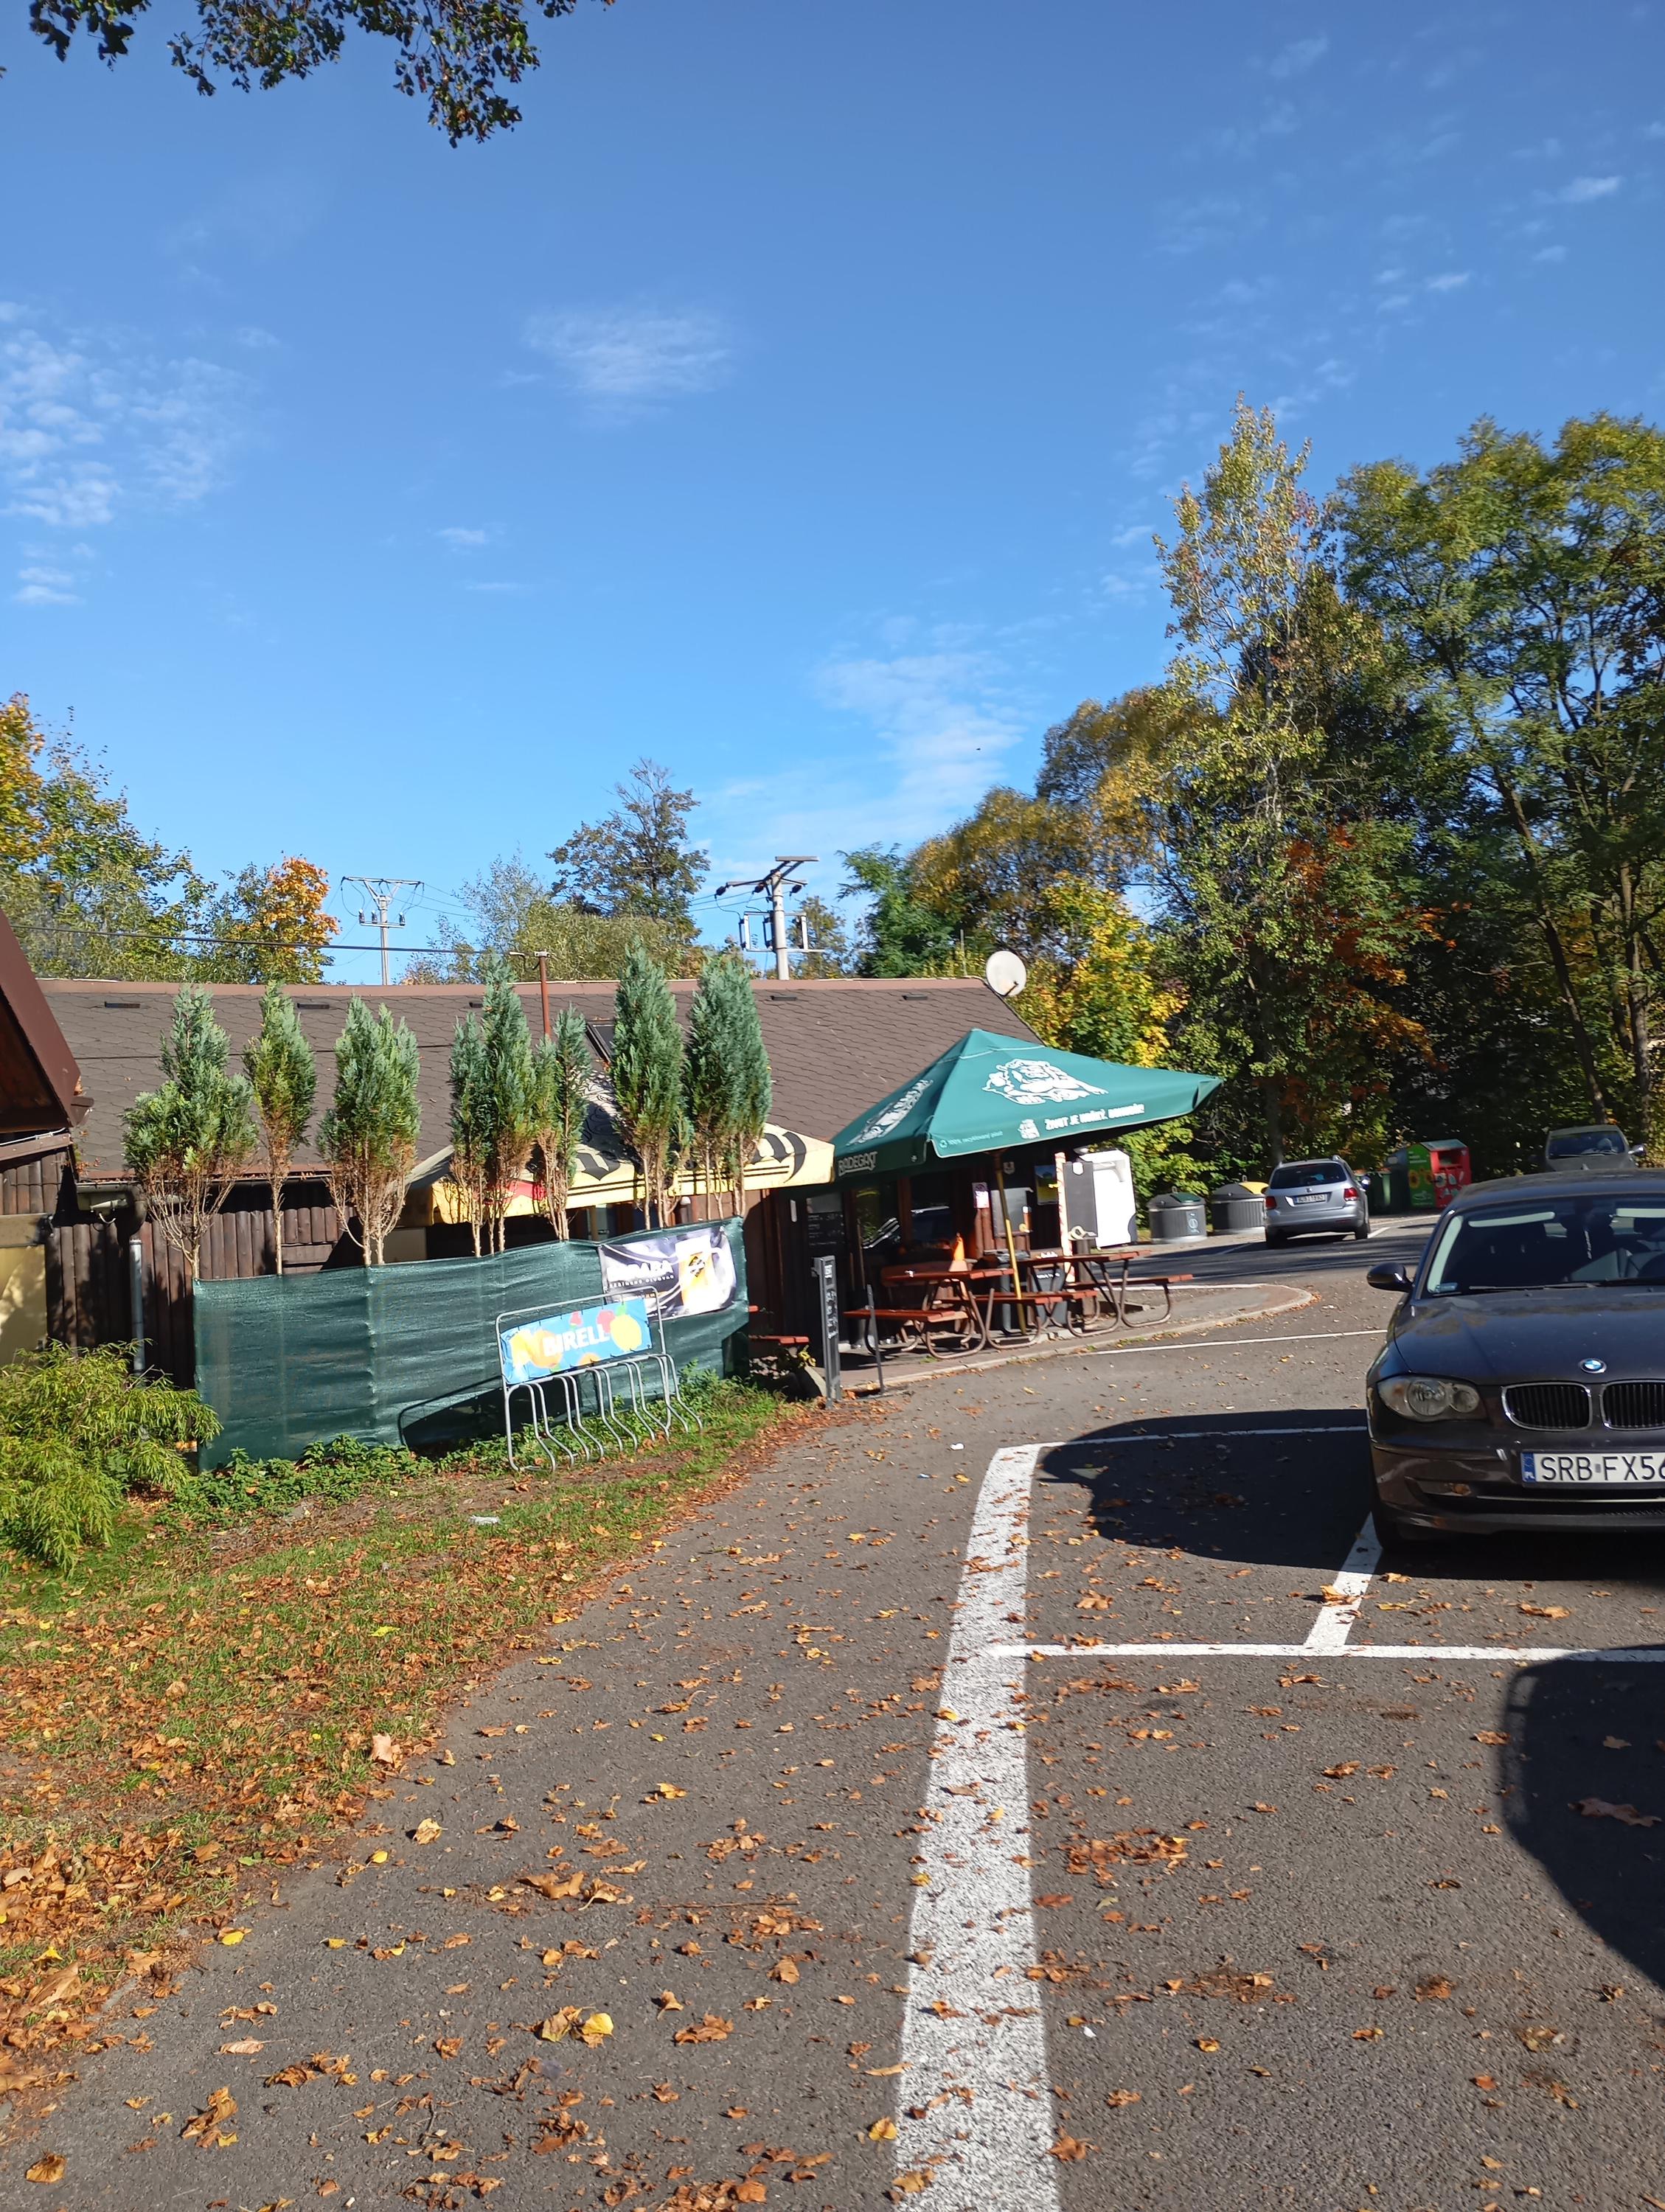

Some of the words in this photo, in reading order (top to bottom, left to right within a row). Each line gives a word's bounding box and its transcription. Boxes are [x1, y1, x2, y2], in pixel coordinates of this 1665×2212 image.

[838, 1151, 878, 1177] RADEGAST
[543, 1324, 611, 1357] BIRELL
[1540, 1456, 1592, 1481] SRB
